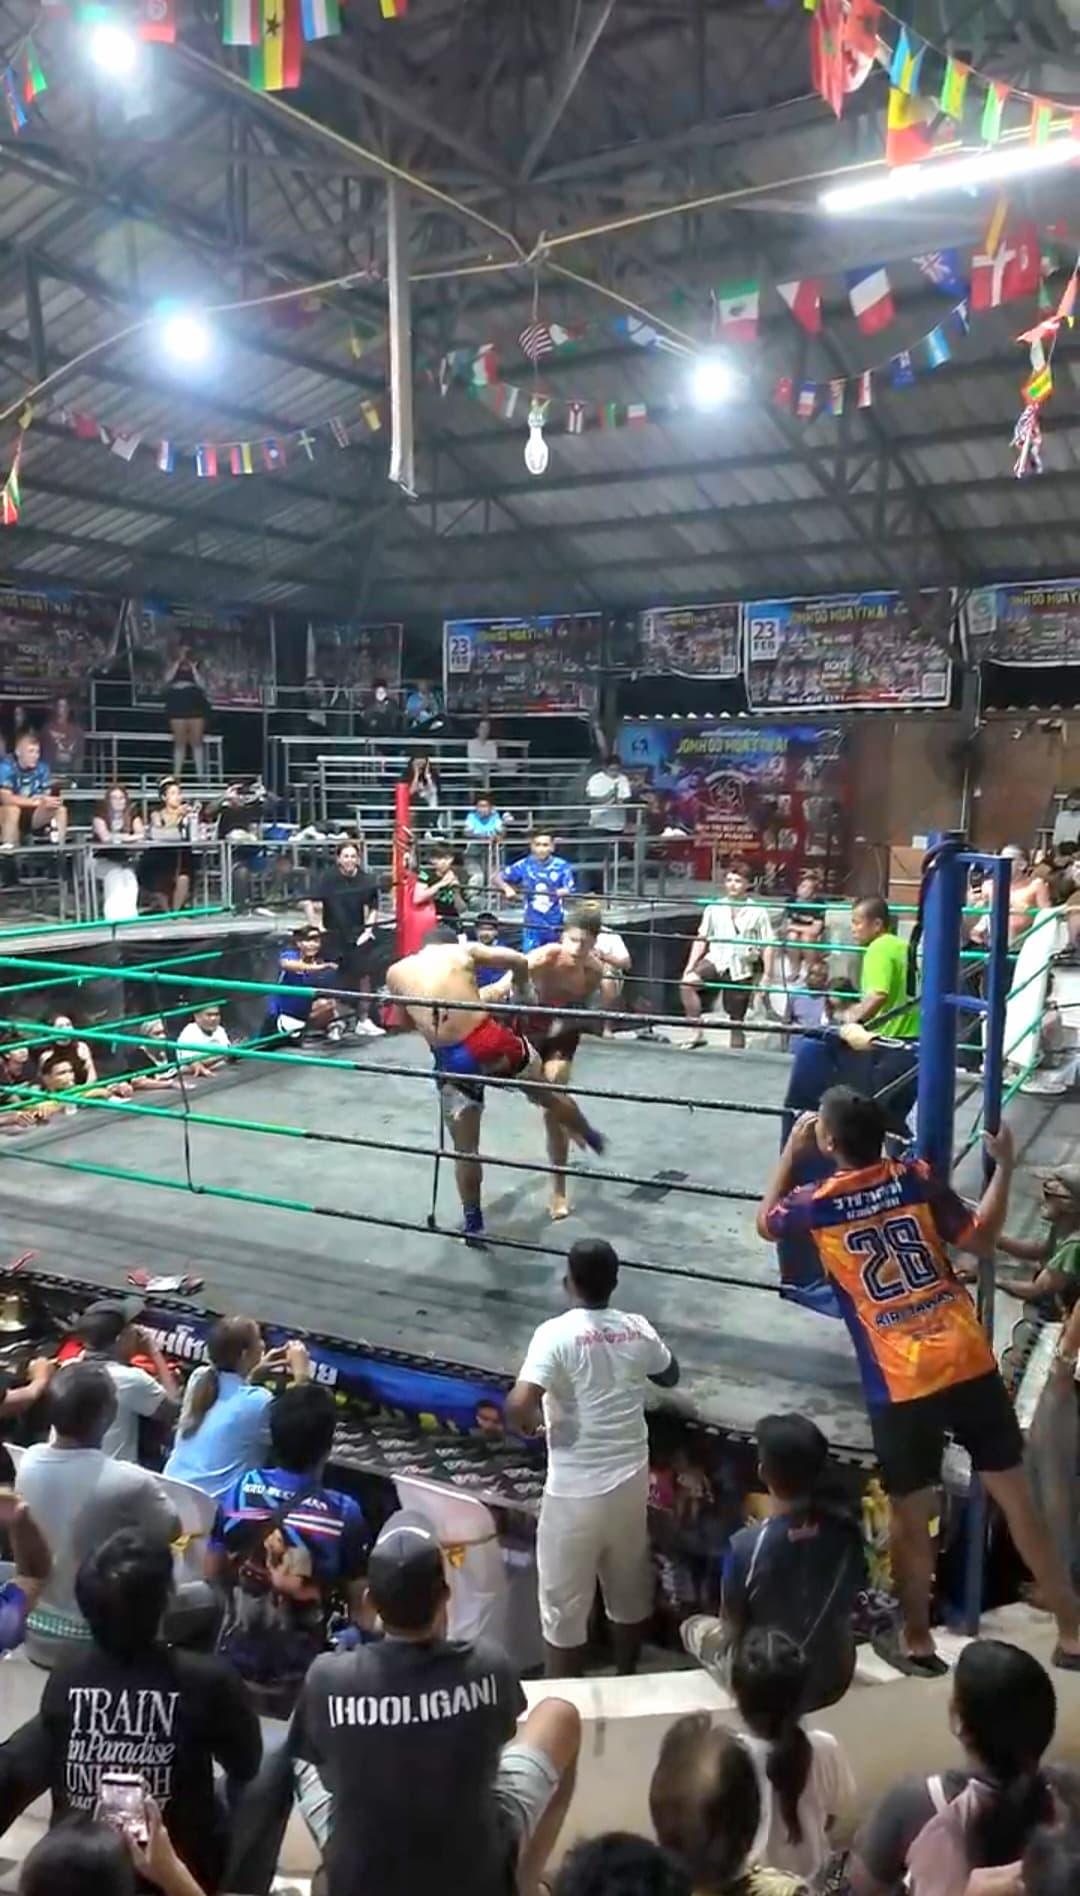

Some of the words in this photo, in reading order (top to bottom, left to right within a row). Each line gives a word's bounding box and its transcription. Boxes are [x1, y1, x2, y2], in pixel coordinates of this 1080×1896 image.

[450, 637, 469, 655] 23
[752, 621, 776, 640] 23
[844, 1215, 940, 1304] 28
[68, 1687, 180, 1736] TRAIN
[86, 1730, 176, 1764] Paradise
